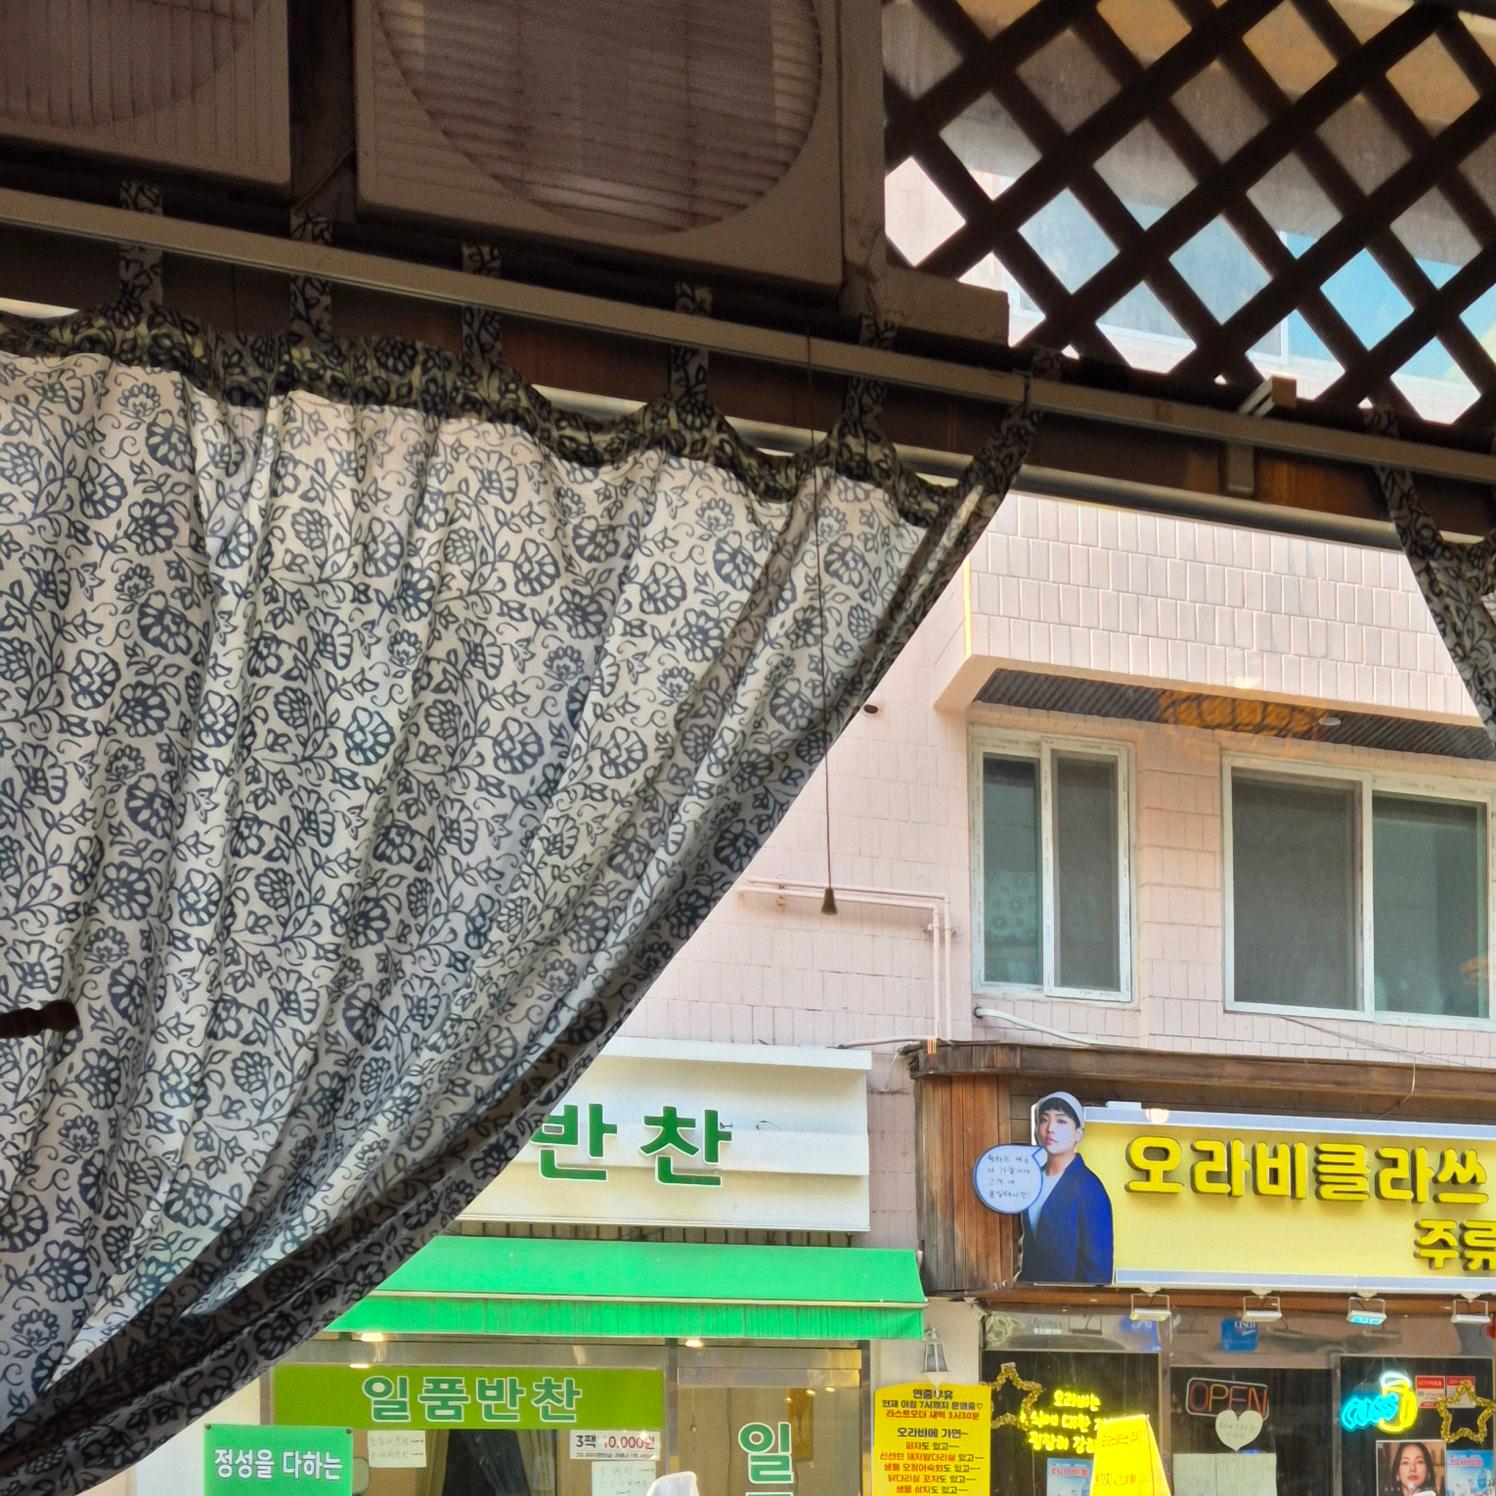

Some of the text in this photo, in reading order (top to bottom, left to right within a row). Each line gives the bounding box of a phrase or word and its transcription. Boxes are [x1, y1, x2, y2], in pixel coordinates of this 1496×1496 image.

[530, 1103, 732, 1187] 반찬
[1124, 1135, 1490, 1203] 오라비클라쓰
[362, 1375, 583, 1423] 일품반찬
[1188, 1382, 1267, 1418] OPEN
[214, 1449, 343, 1481] 정성을 다하는
